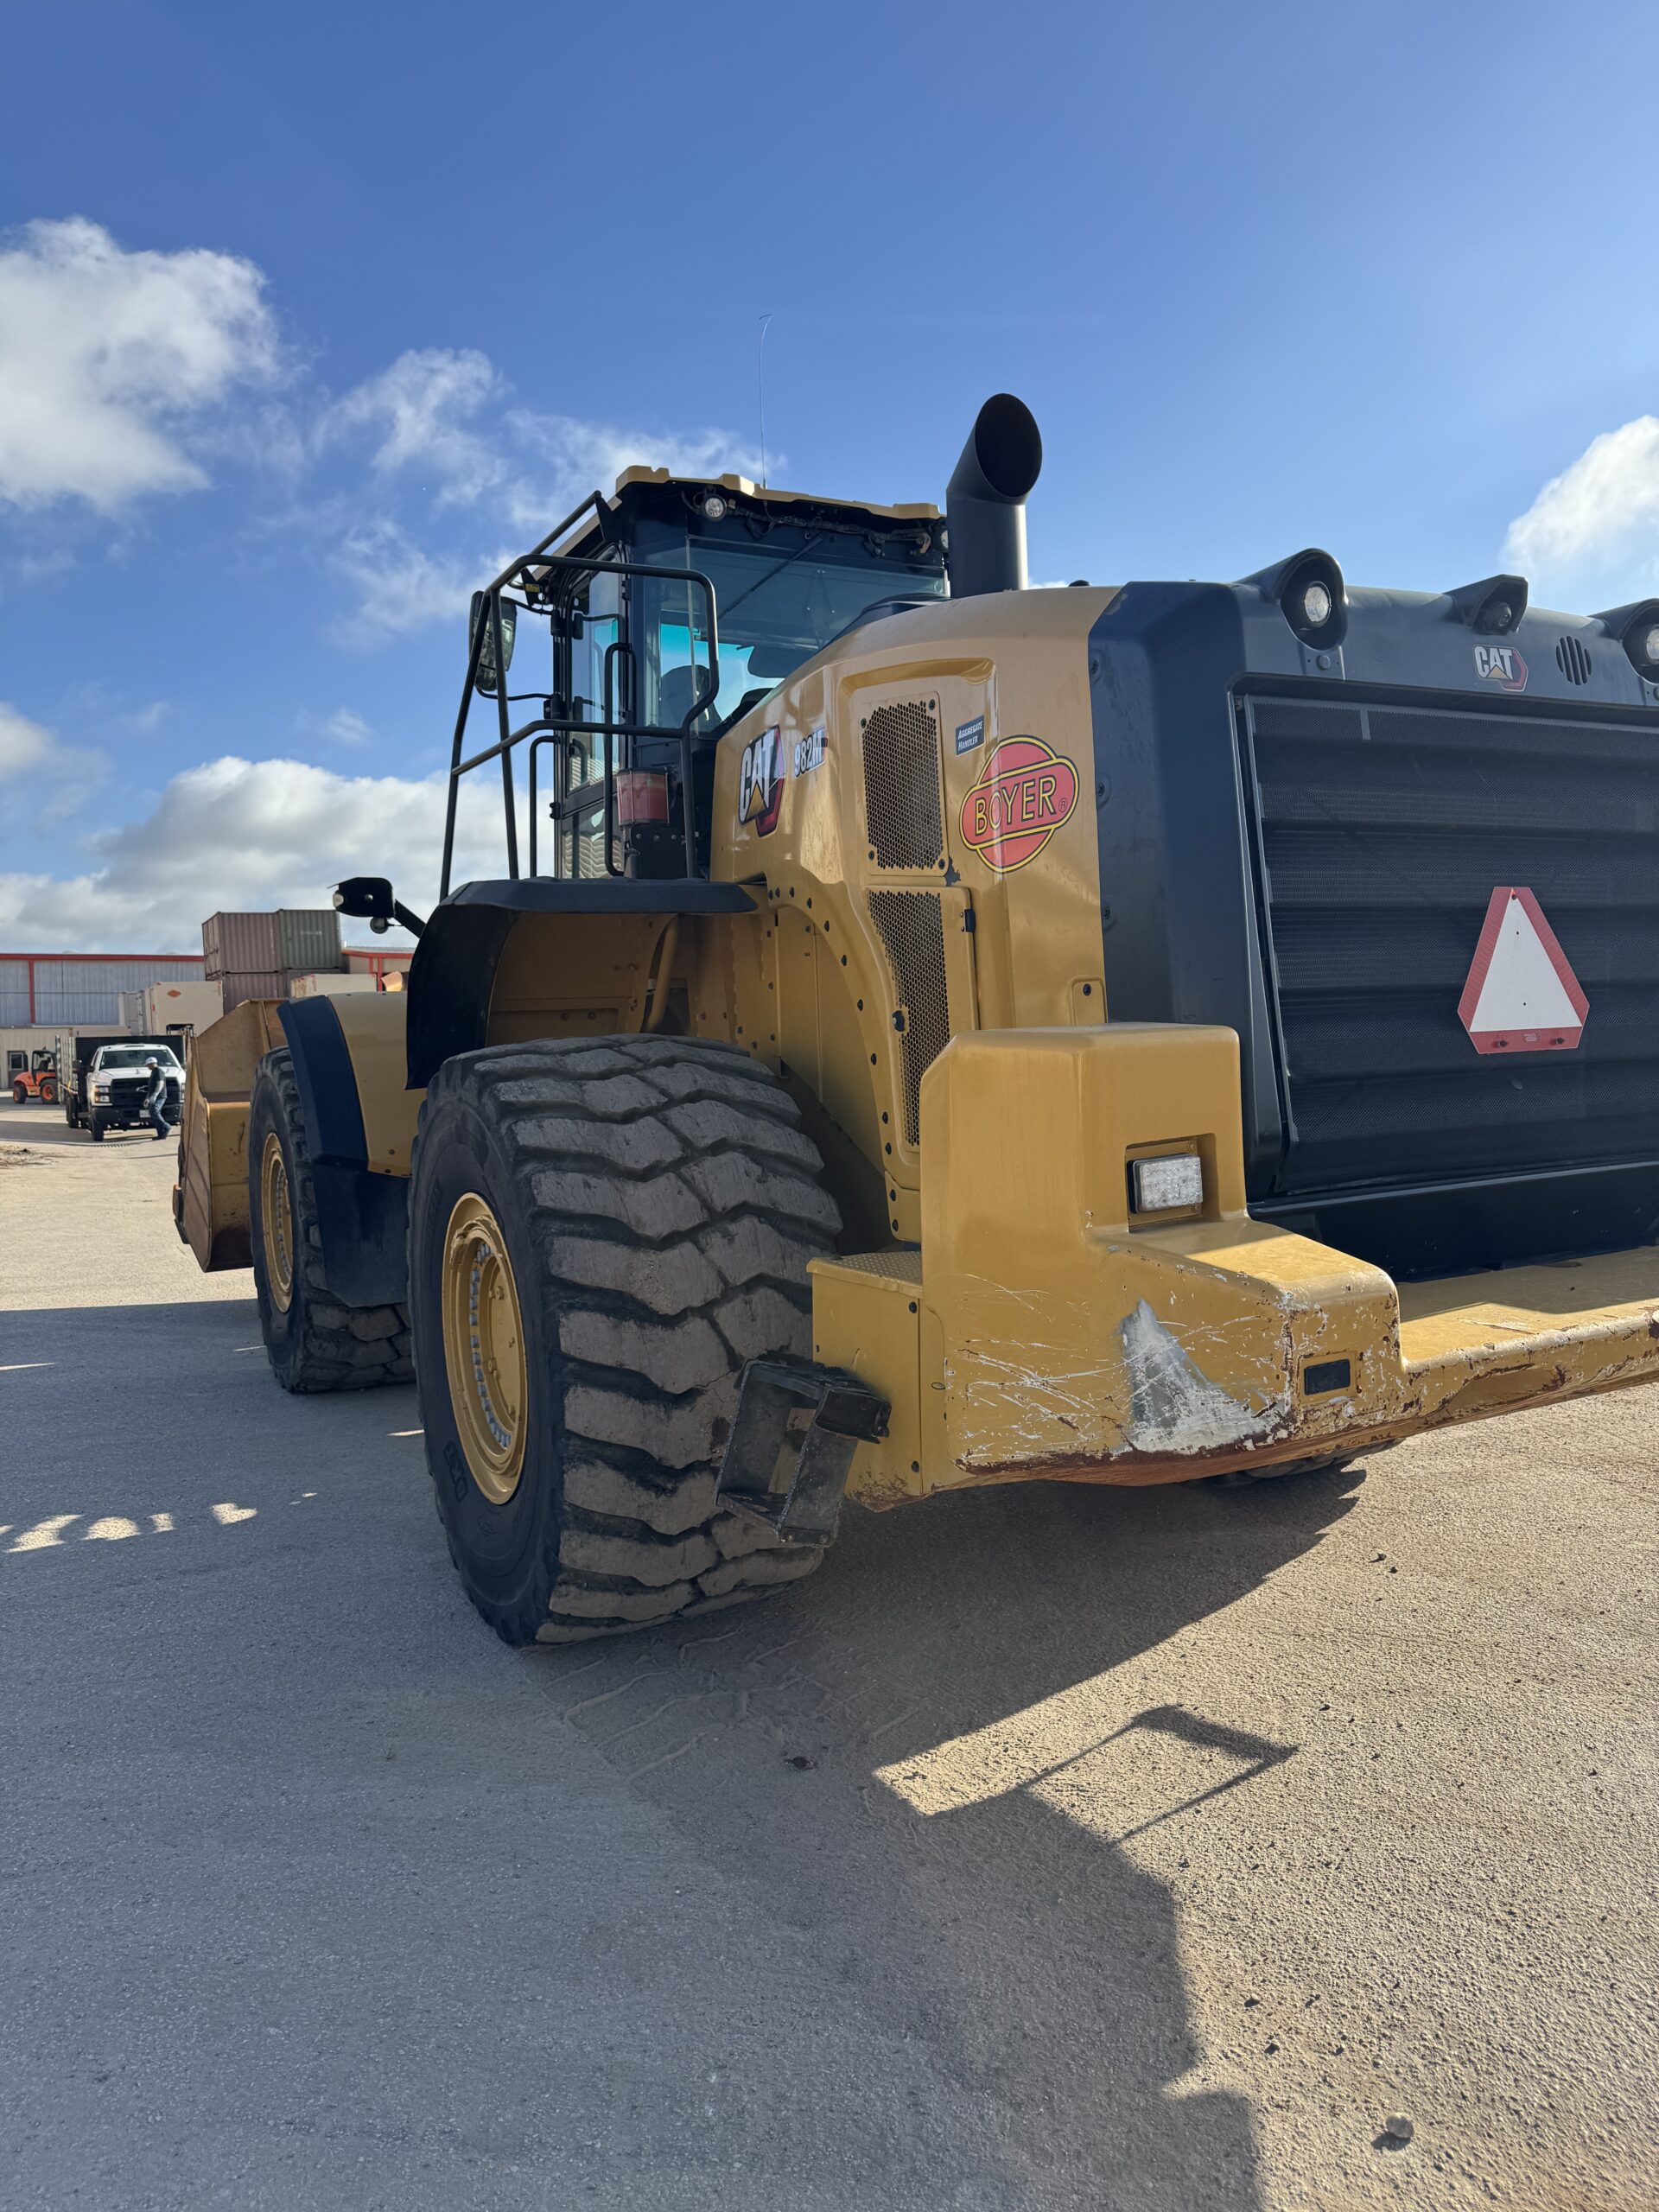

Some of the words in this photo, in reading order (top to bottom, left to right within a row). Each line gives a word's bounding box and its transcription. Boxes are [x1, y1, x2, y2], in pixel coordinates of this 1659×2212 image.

[1474, 646, 1514, 680] CAT
[740, 728, 776, 823] CAT
[794, 729, 823, 777] 982M
[976, 776, 1057, 836] BOYER
